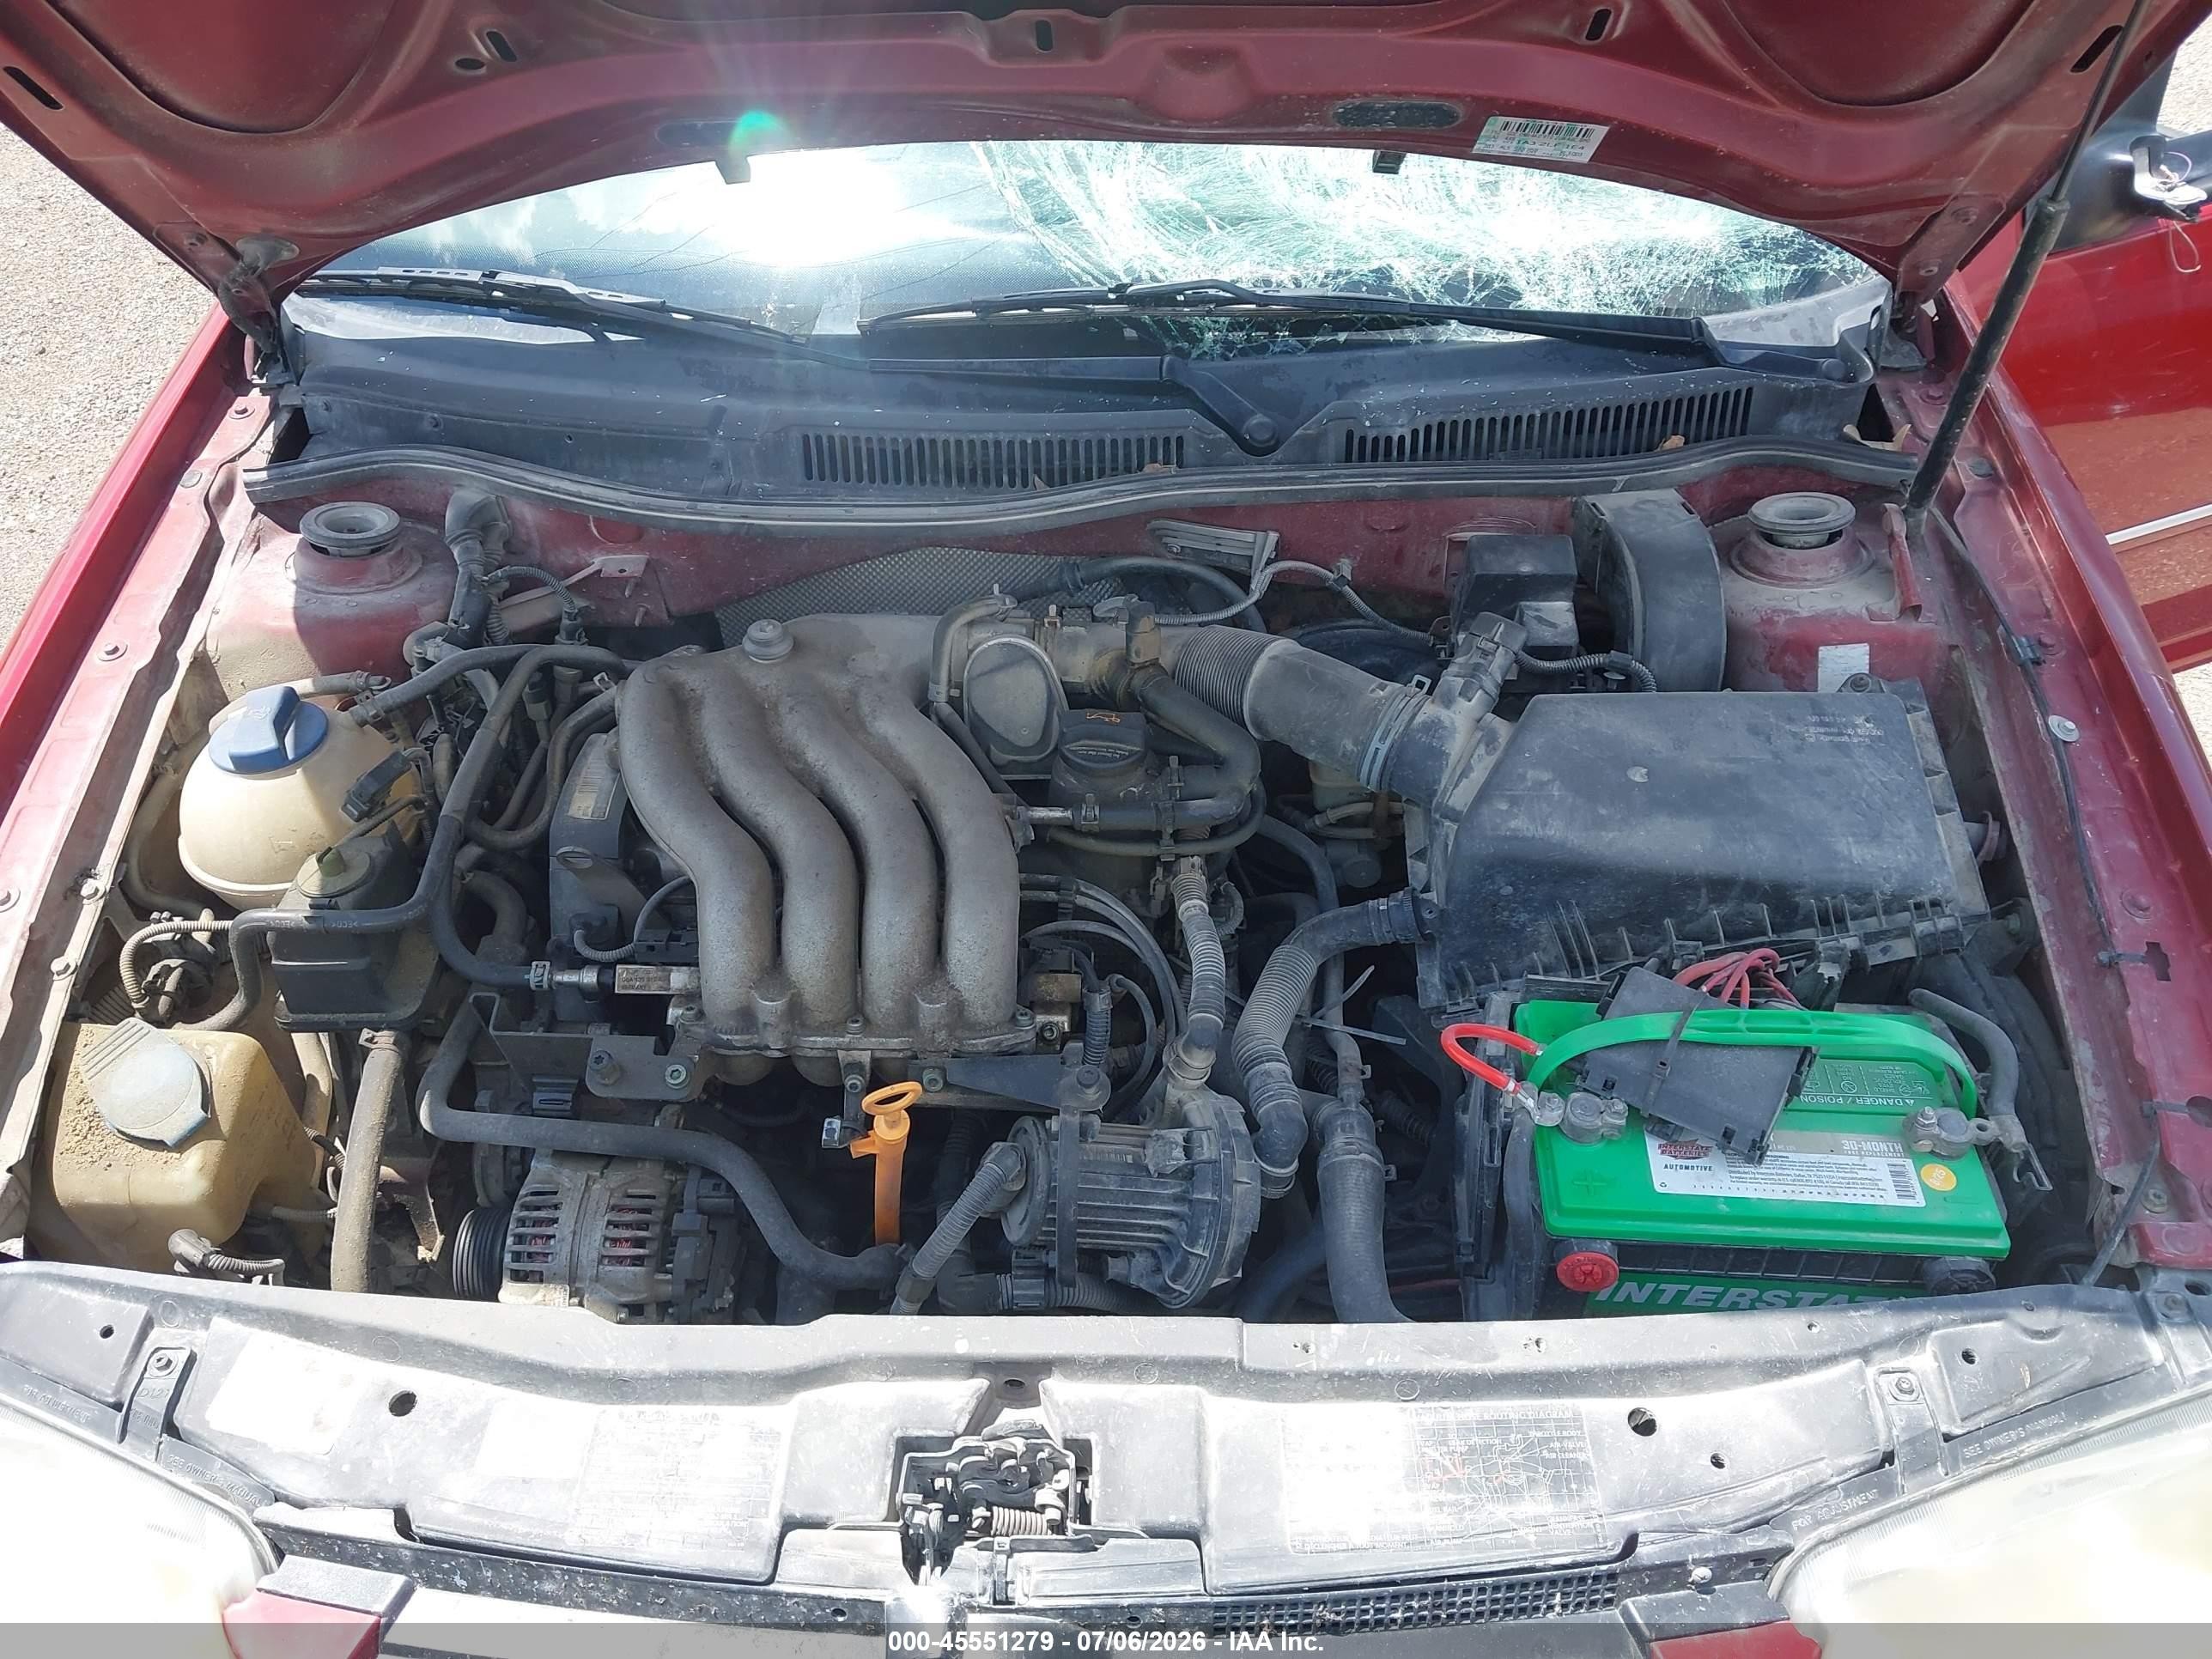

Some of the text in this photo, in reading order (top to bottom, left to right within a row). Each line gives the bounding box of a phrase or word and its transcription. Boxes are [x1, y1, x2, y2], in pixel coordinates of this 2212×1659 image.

[1799, 1095, 1844, 1104] POISON
[1856, 1097, 1904, 1107] DANGER
[1663, 1163, 1714, 1172] AUTOMOTIVE
[1528, 1409, 1572, 1419] DIAGRAM
[1962, 1443, 1984, 1459] SEE
